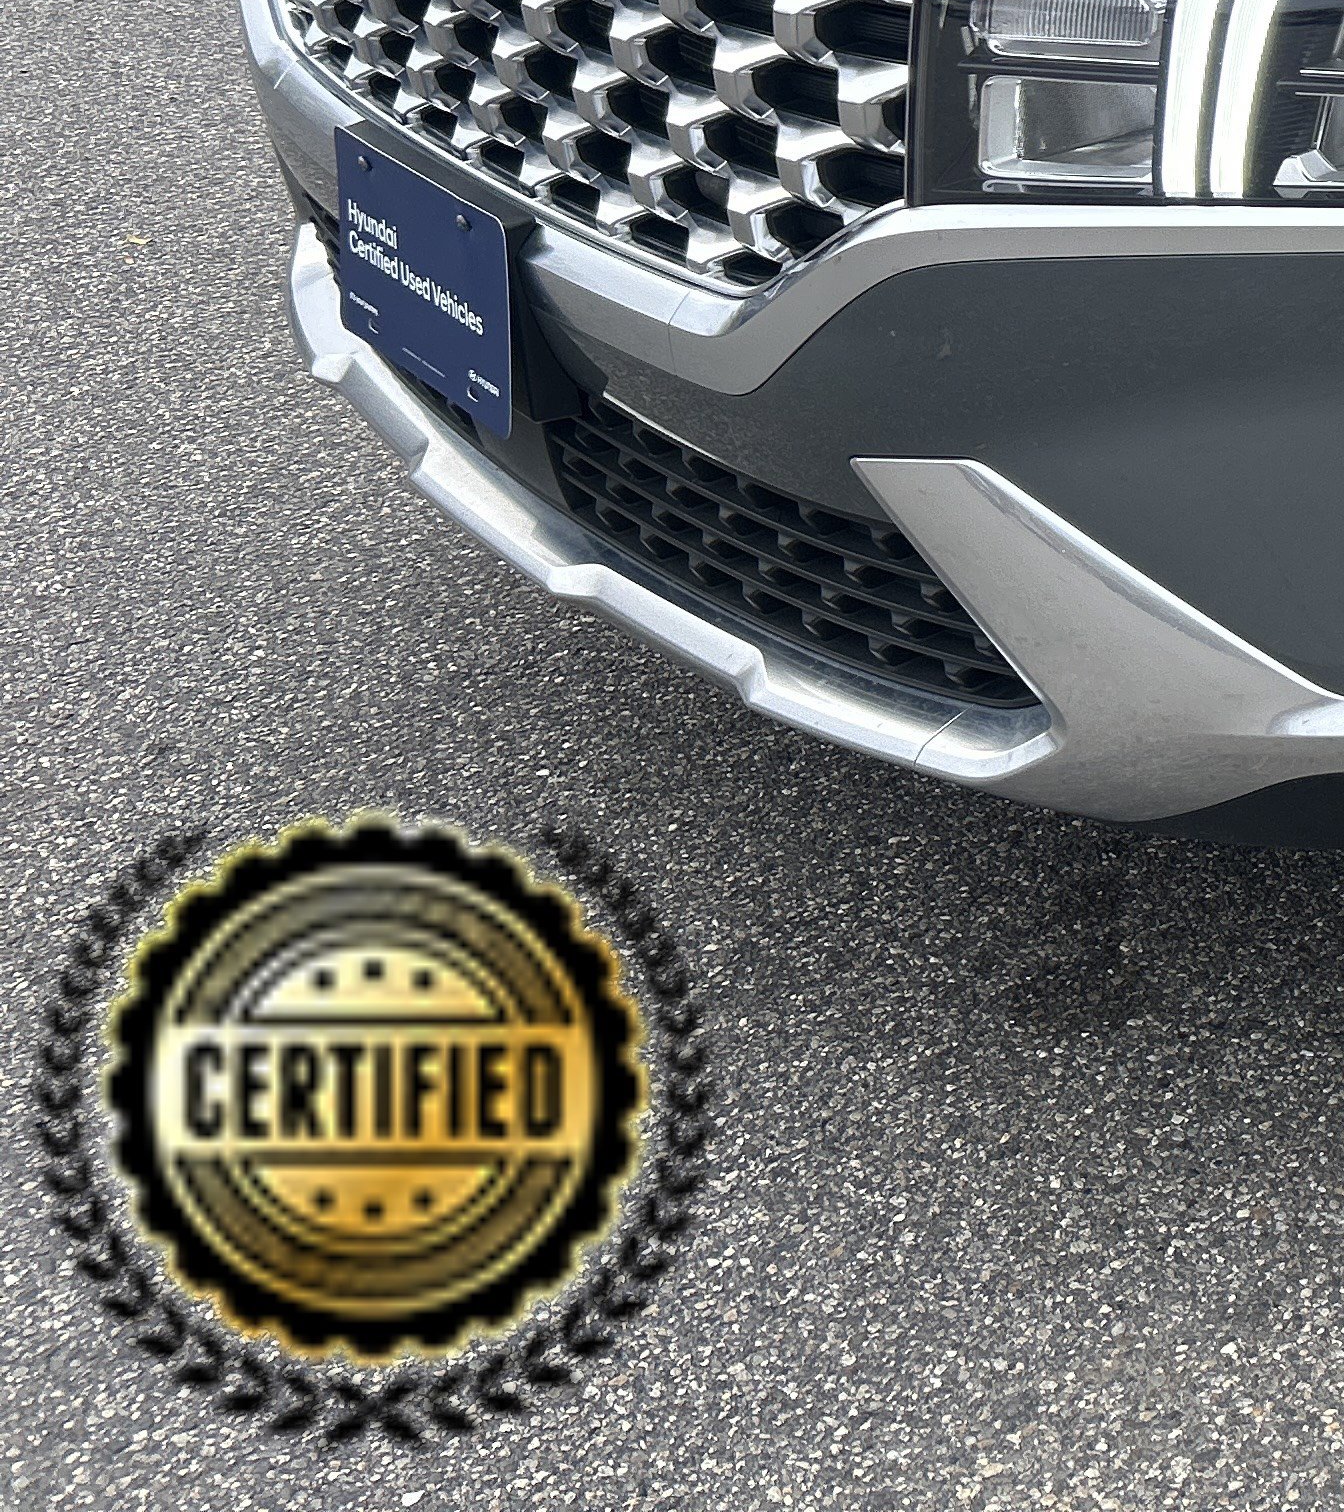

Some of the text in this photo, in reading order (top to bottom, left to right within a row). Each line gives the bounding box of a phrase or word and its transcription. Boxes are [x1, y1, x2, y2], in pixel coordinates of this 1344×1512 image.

[347, 198, 398, 250] Hyundai
[349, 230, 399, 280] Certified
[400, 261, 431, 301] Used
[431, 281, 484, 336] Vehicles
